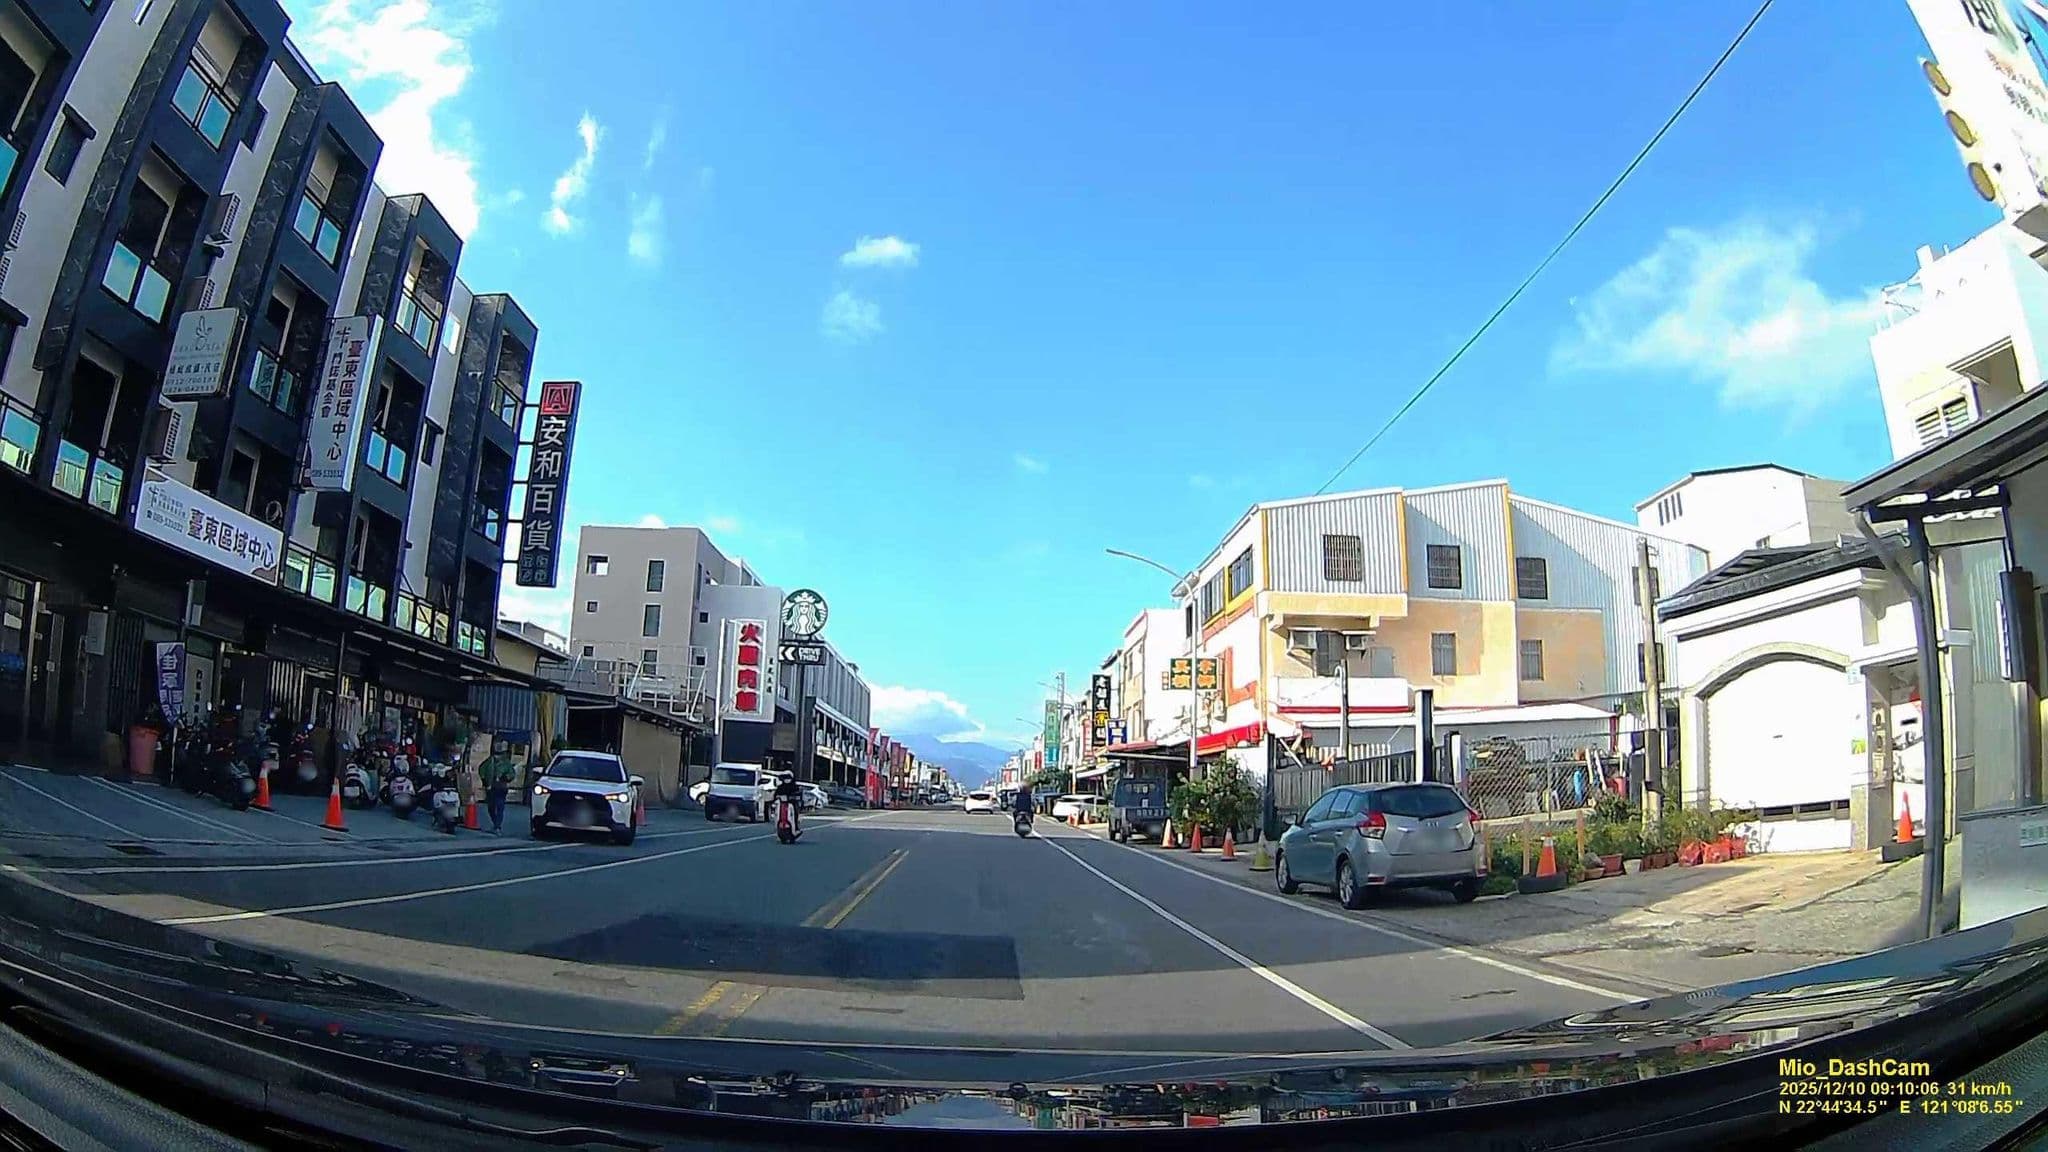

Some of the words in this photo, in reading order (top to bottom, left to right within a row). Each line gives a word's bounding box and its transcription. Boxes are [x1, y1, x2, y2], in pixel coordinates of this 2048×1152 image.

[327, 340, 365, 461] 臺東區域中心
[523, 415, 567, 552] 安和百貨
[187, 508, 275, 568] 臺東區域中心
[735, 622, 761, 712] 火肉
